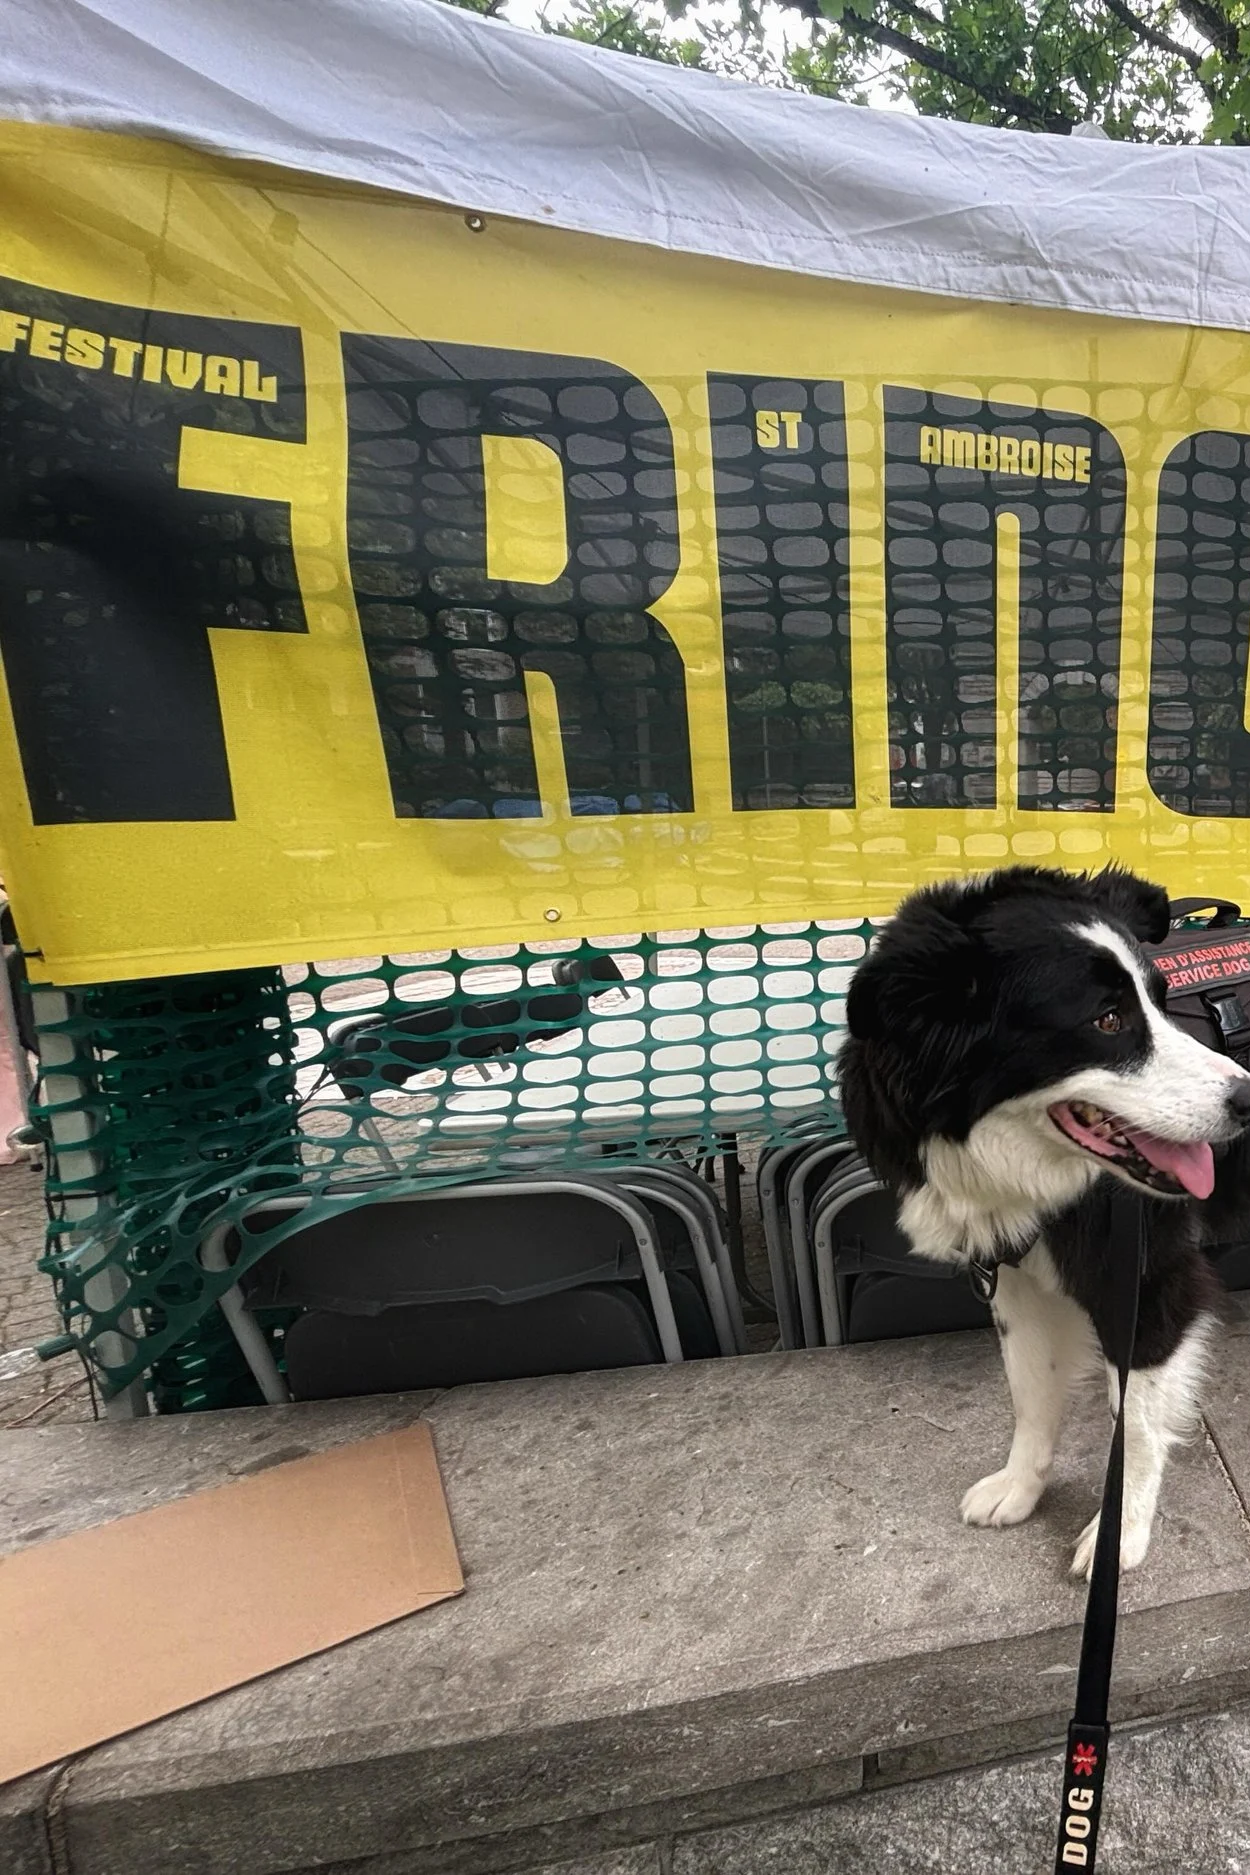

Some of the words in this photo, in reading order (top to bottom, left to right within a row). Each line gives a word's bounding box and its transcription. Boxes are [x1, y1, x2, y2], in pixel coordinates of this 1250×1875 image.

[0, 310, 277, 403] FESTIVAL
[756, 410, 802, 448] ST
[920, 425, 1092, 484] AMBROISE
[1153, 957, 1178, 971] IEN
[1062, 1787, 1094, 1866] DOG
